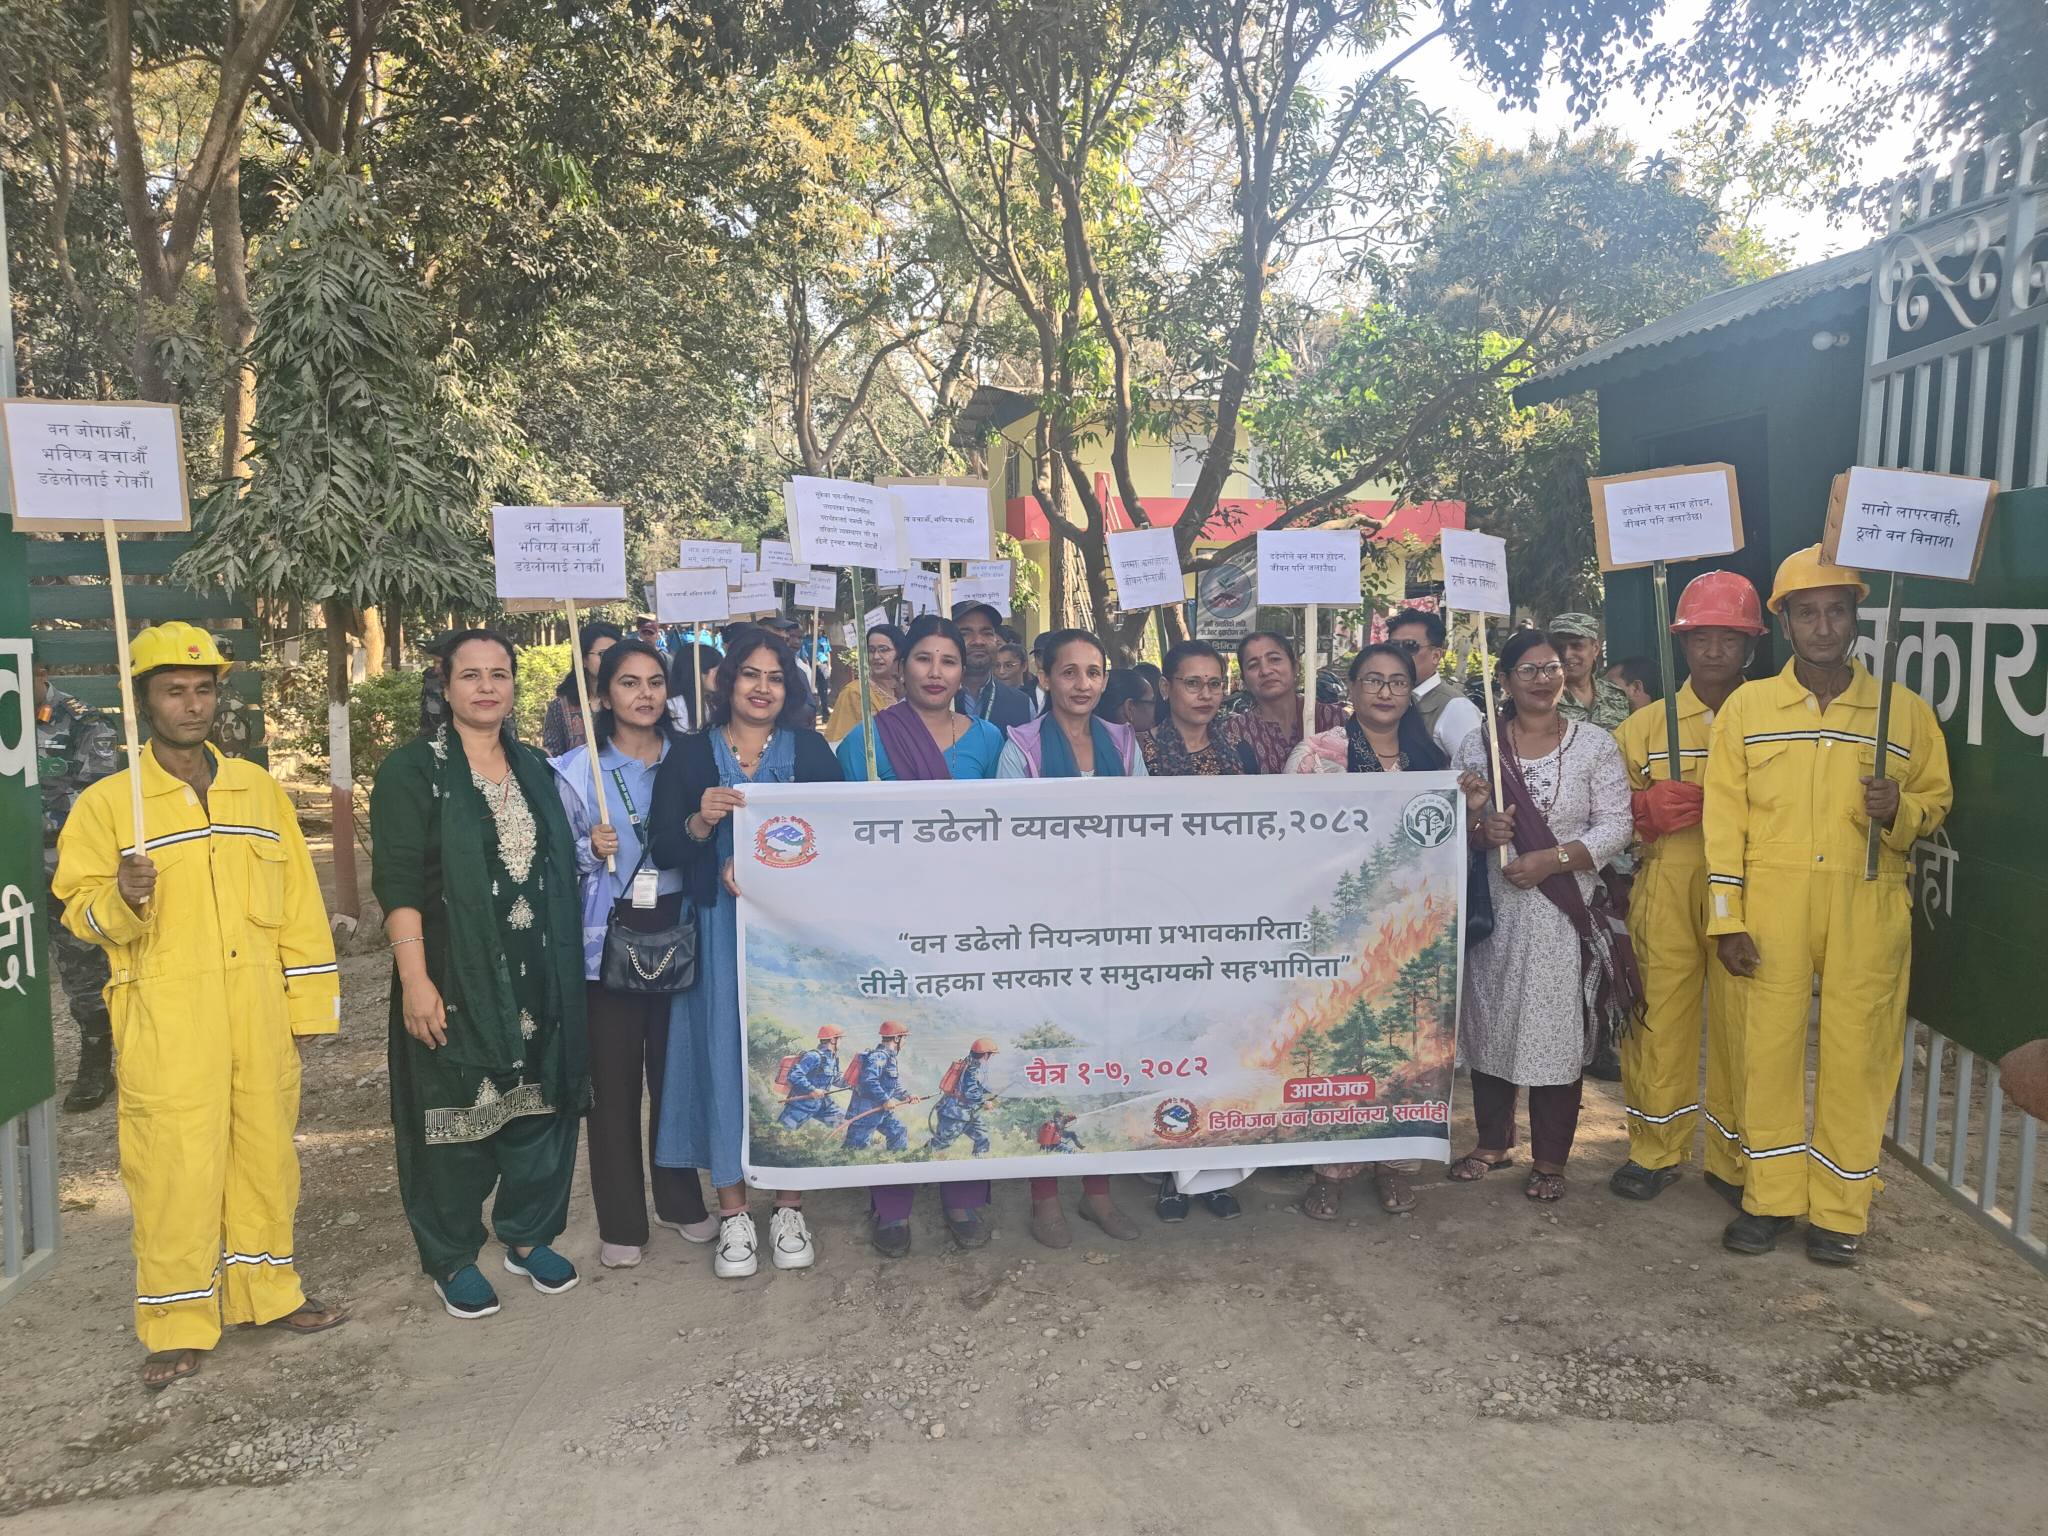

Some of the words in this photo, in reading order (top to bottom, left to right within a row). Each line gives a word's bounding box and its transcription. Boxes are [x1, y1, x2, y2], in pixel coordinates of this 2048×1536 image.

[46, 423, 70, 437] वन
[42, 443, 92, 462] भविष्य
[1861, 501, 1892, 517] सानो
[524, 522, 540, 533] वन
[1856, 524, 1882, 542] ठूलो
[1886, 530, 1907, 542] वन
[518, 537, 557, 553] भविष्य
[853, 819, 903, 845] वन
[912, 808, 1002, 843] डढेलो
[1010, 813, 1173, 840] व्यवस्थापन
[954, 924, 1022, 952] डढेलो
[1028, 923, 1152, 949] नियन्त्रणमा
[859, 968, 908, 995] तीनै
[915, 972, 985, 998] तहका
[992, 967, 1074, 990] सरकार
[1080, 967, 1093, 986] र
[1100, 955, 1214, 991] समुदायको
[1025, 1058, 1068, 1085] चैत्र
[1141, 1056, 1208, 1079] २०८२
[1289, 1078, 1370, 1099] आयोजक
[1209, 1110, 1277, 1130] डिभिजन
[1282, 1109, 1308, 1126] वन
[1393, 1100, 1448, 1122] सर्लाही
